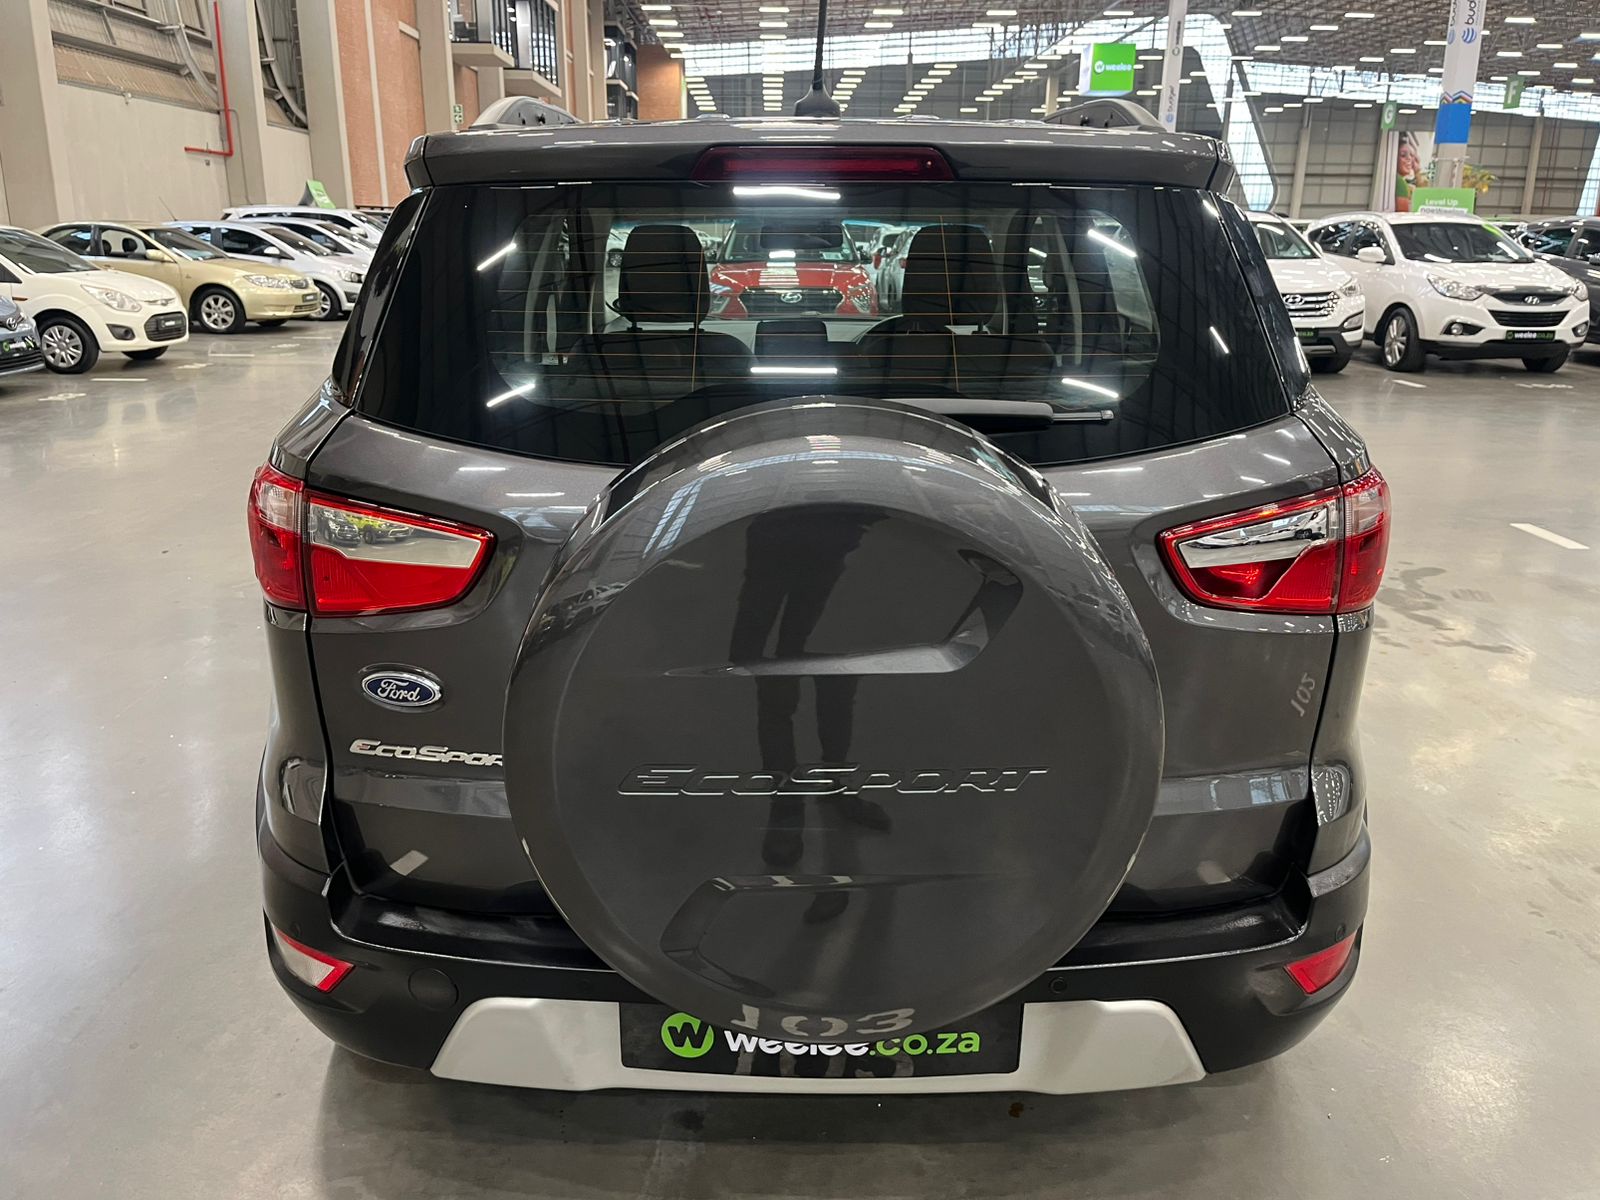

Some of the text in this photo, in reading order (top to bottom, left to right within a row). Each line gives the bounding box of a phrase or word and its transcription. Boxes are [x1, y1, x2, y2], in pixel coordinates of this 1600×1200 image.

[1507, 79, 1519, 105] F
[1384, 104, 1394, 125] G
[1425, 197, 1459, 208] Level Up
[377, 678, 421, 702] Ford
